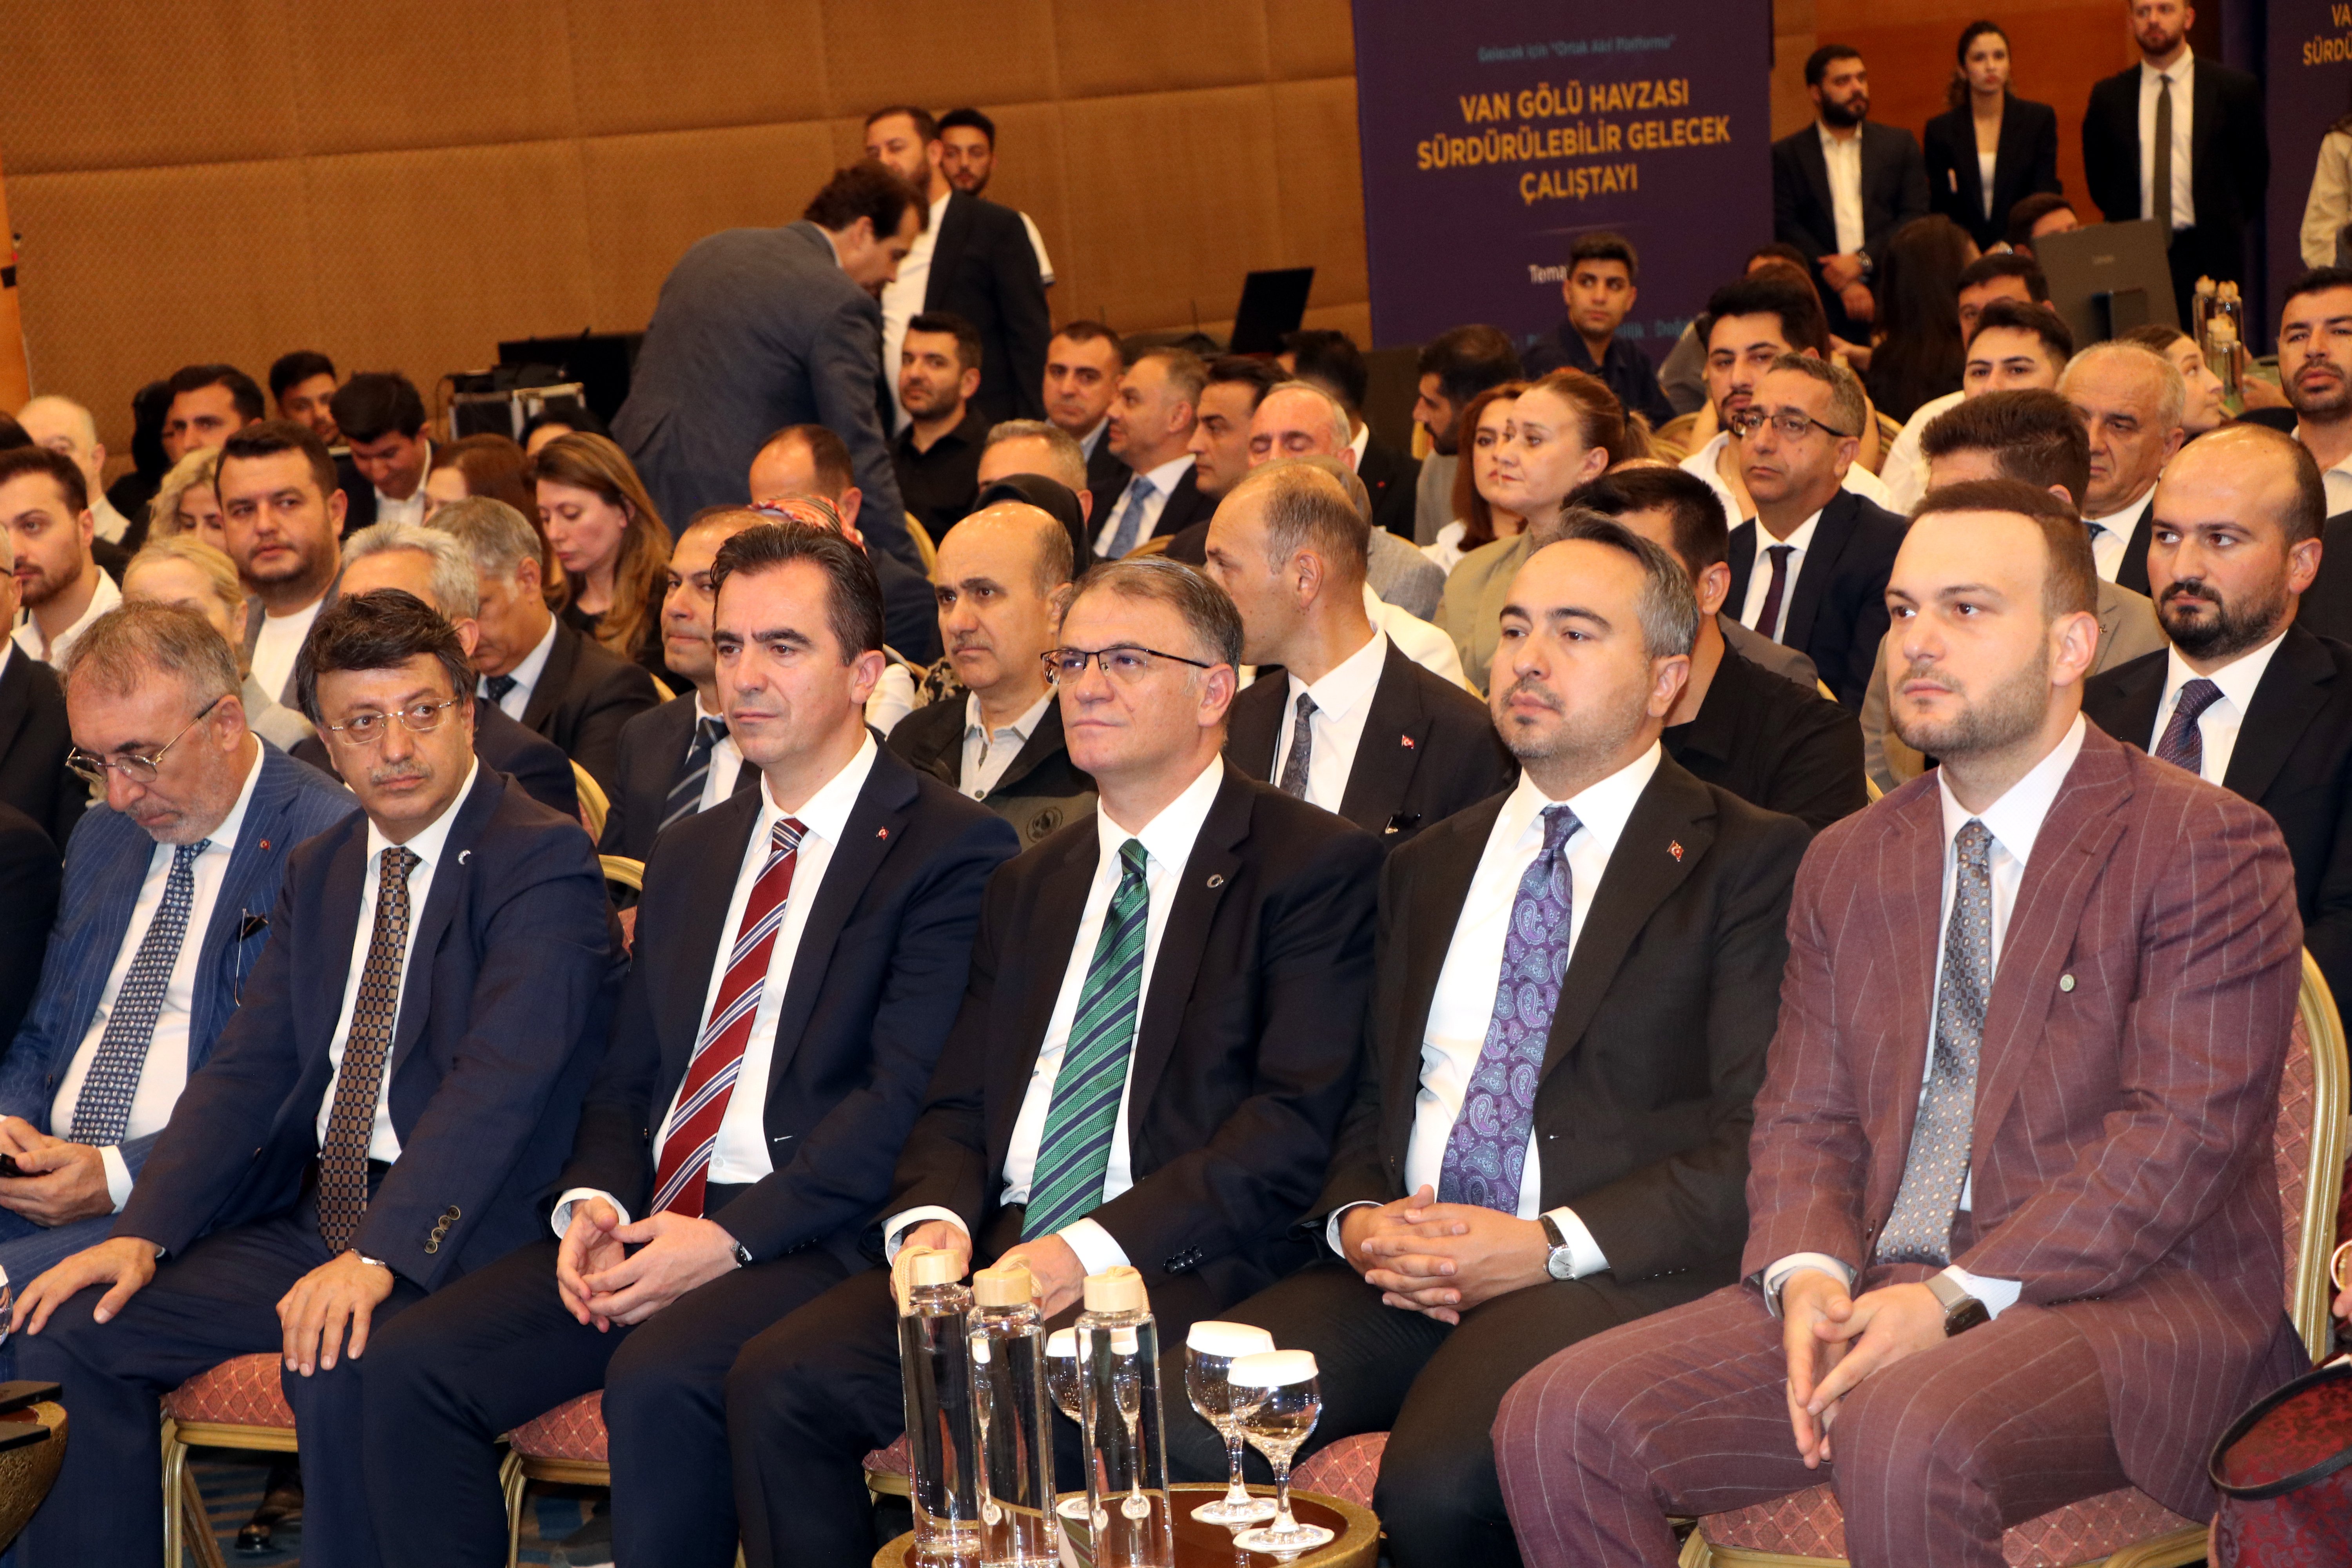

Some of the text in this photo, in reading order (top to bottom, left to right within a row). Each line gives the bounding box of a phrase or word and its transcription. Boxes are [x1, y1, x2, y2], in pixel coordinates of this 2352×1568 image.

[1459, 79, 1689, 123] VAN GÖLÜ HAVZASI
[1417, 116, 1731, 170] SÜRDÜRÜLEBİLİR GELECEK
[1519, 163, 1638, 205] ÇALIŞTAYI
